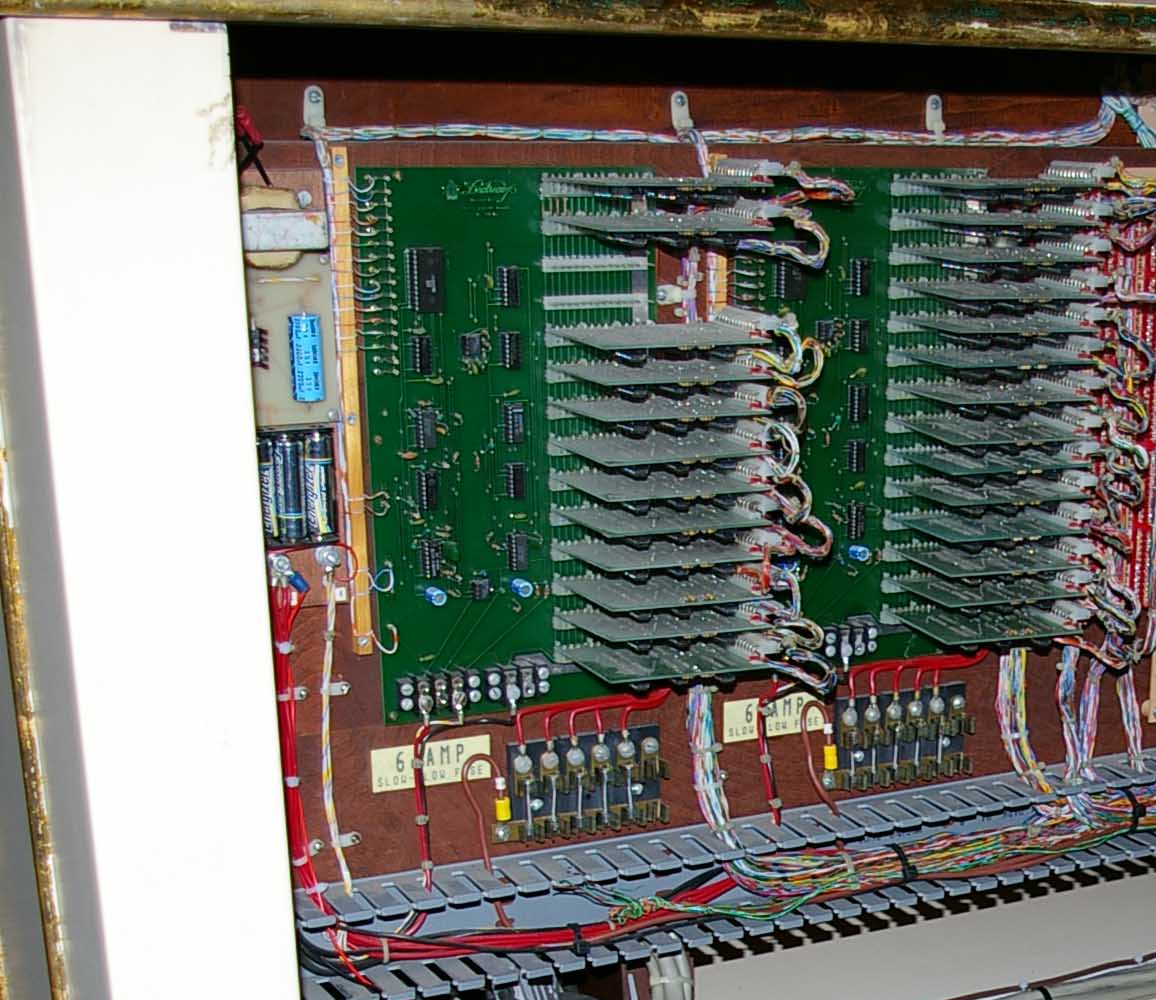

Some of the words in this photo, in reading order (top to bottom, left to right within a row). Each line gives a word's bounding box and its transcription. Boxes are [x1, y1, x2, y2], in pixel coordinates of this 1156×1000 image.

[745, 703, 754, 724] 6
[768, 696, 804, 717] AMP
[396, 751, 405, 773] 6
[426, 743, 465, 767] AMP
[454, 764, 484, 777] FSE
